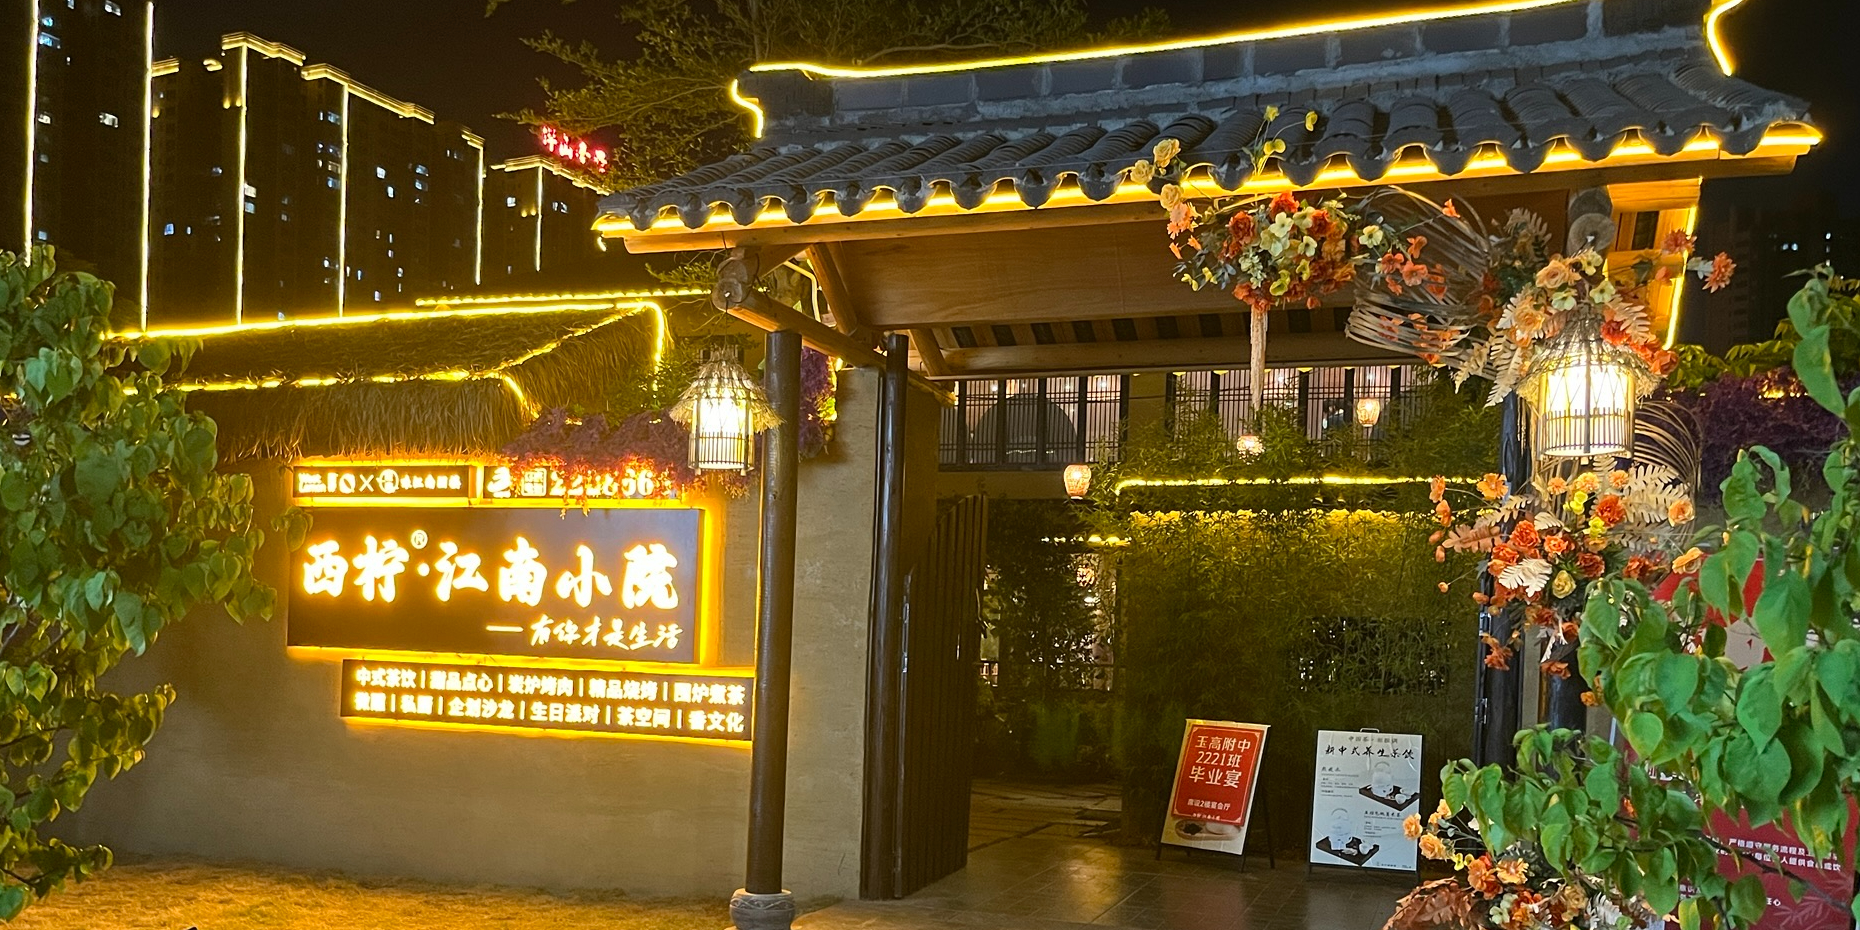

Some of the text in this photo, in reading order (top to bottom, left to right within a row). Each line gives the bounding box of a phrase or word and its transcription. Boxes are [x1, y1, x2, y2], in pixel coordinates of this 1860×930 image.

[356, 667, 416, 688] 中式茶饮
[531, 701, 600, 724] 生日派对
[1195, 735, 1251, 753] 玉高附中
[1195, 751, 1242, 768] 2221班
[1189, 766, 1242, 788] 毕业宴
